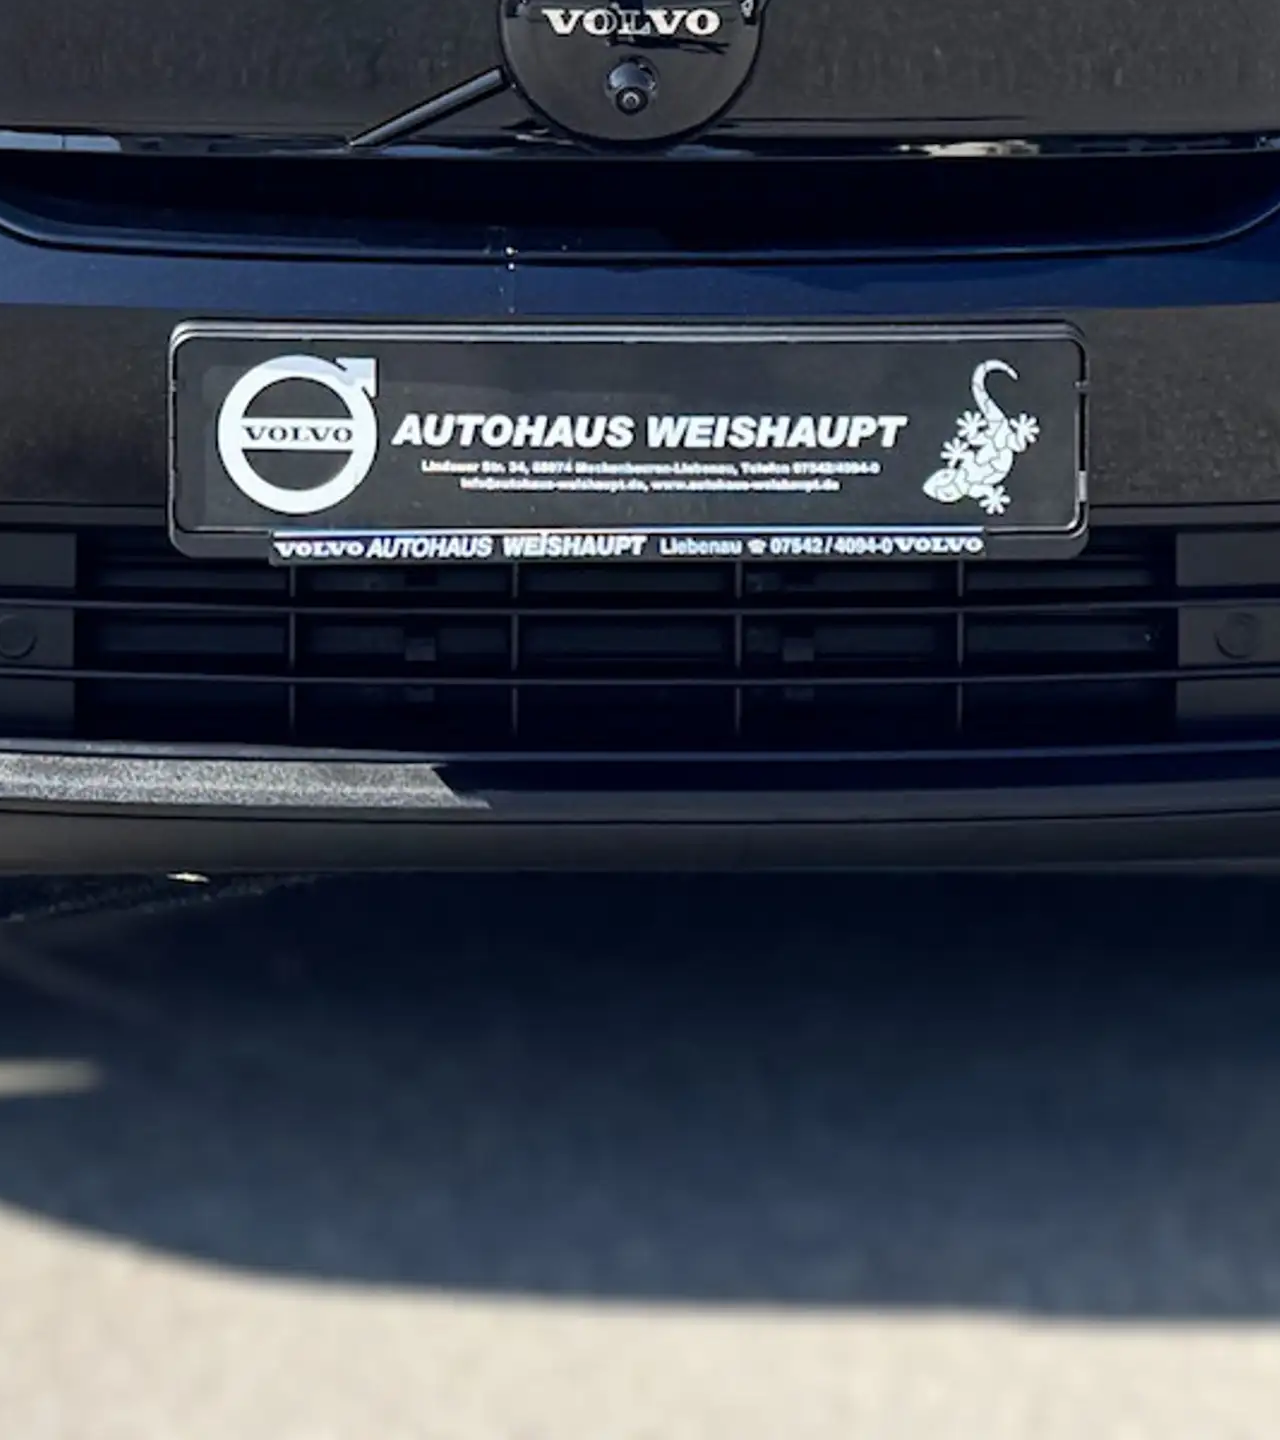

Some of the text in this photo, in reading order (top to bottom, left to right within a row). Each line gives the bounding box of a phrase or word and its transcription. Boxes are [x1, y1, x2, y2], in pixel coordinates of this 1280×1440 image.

[542, 9, 720, 36] VOLVO
[242, 425, 354, 443] VOLVO
[391, 413, 908, 448] AUTOHAUS WEISHAUPT
[273, 540, 365, 558] VOLVO
[365, 536, 493, 558] AUTOHAUS
[502, 535, 648, 557] WEISHAUPT
[659, 537, 742, 556] Liebenau
[893, 536, 984, 553] VOLVO
